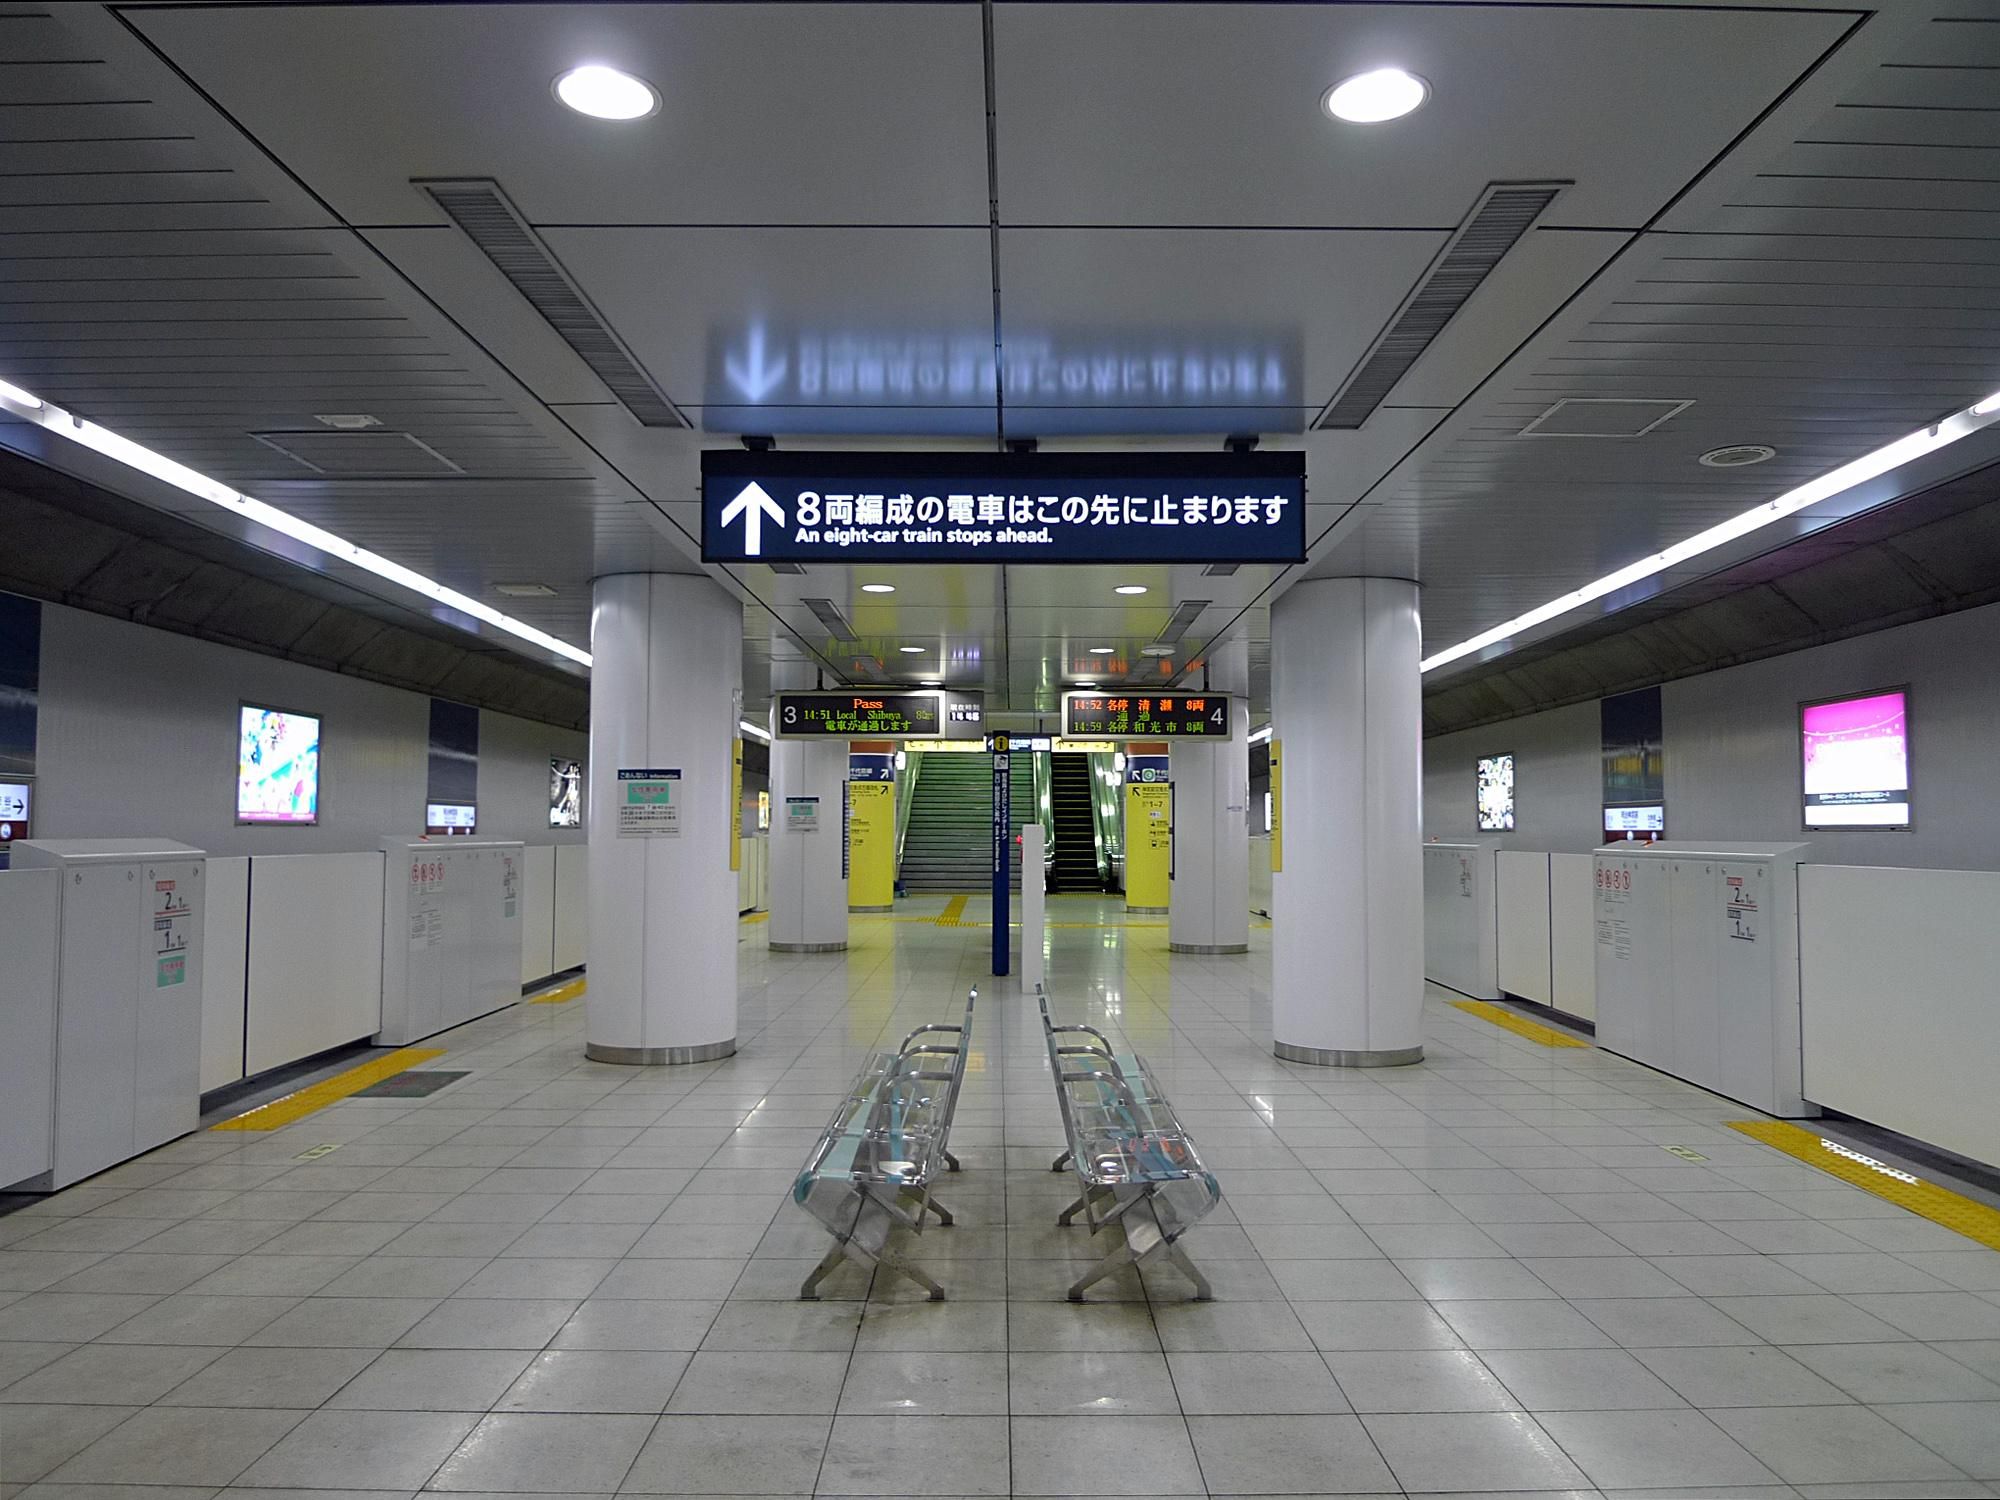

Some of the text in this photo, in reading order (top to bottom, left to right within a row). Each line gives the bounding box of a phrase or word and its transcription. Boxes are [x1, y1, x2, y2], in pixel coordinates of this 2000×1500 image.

[796, 491, 1289, 526] 8両編成の電車はこの先に止まります
[795, 527, 1054, 547] An eight-car train stops ahead.
[853, 698, 884, 710] Pass
[1073, 699, 1102, 710] 14:52
[1107, 699, 1129, 711] 各停
[783, 706, 798, 724] 3
[803, 709, 831, 720] 14:51
[836, 709, 857, 720] Local
[867, 709, 902, 721] Shibuya
[1210, 707, 1225, 725] 4
[825, 720, 912, 732] 電車が通過します
[1073, 721, 1102, 732] 14:59
[1107, 721, 1129, 733] 各停
[1134, 721, 1178, 733] 和光市
